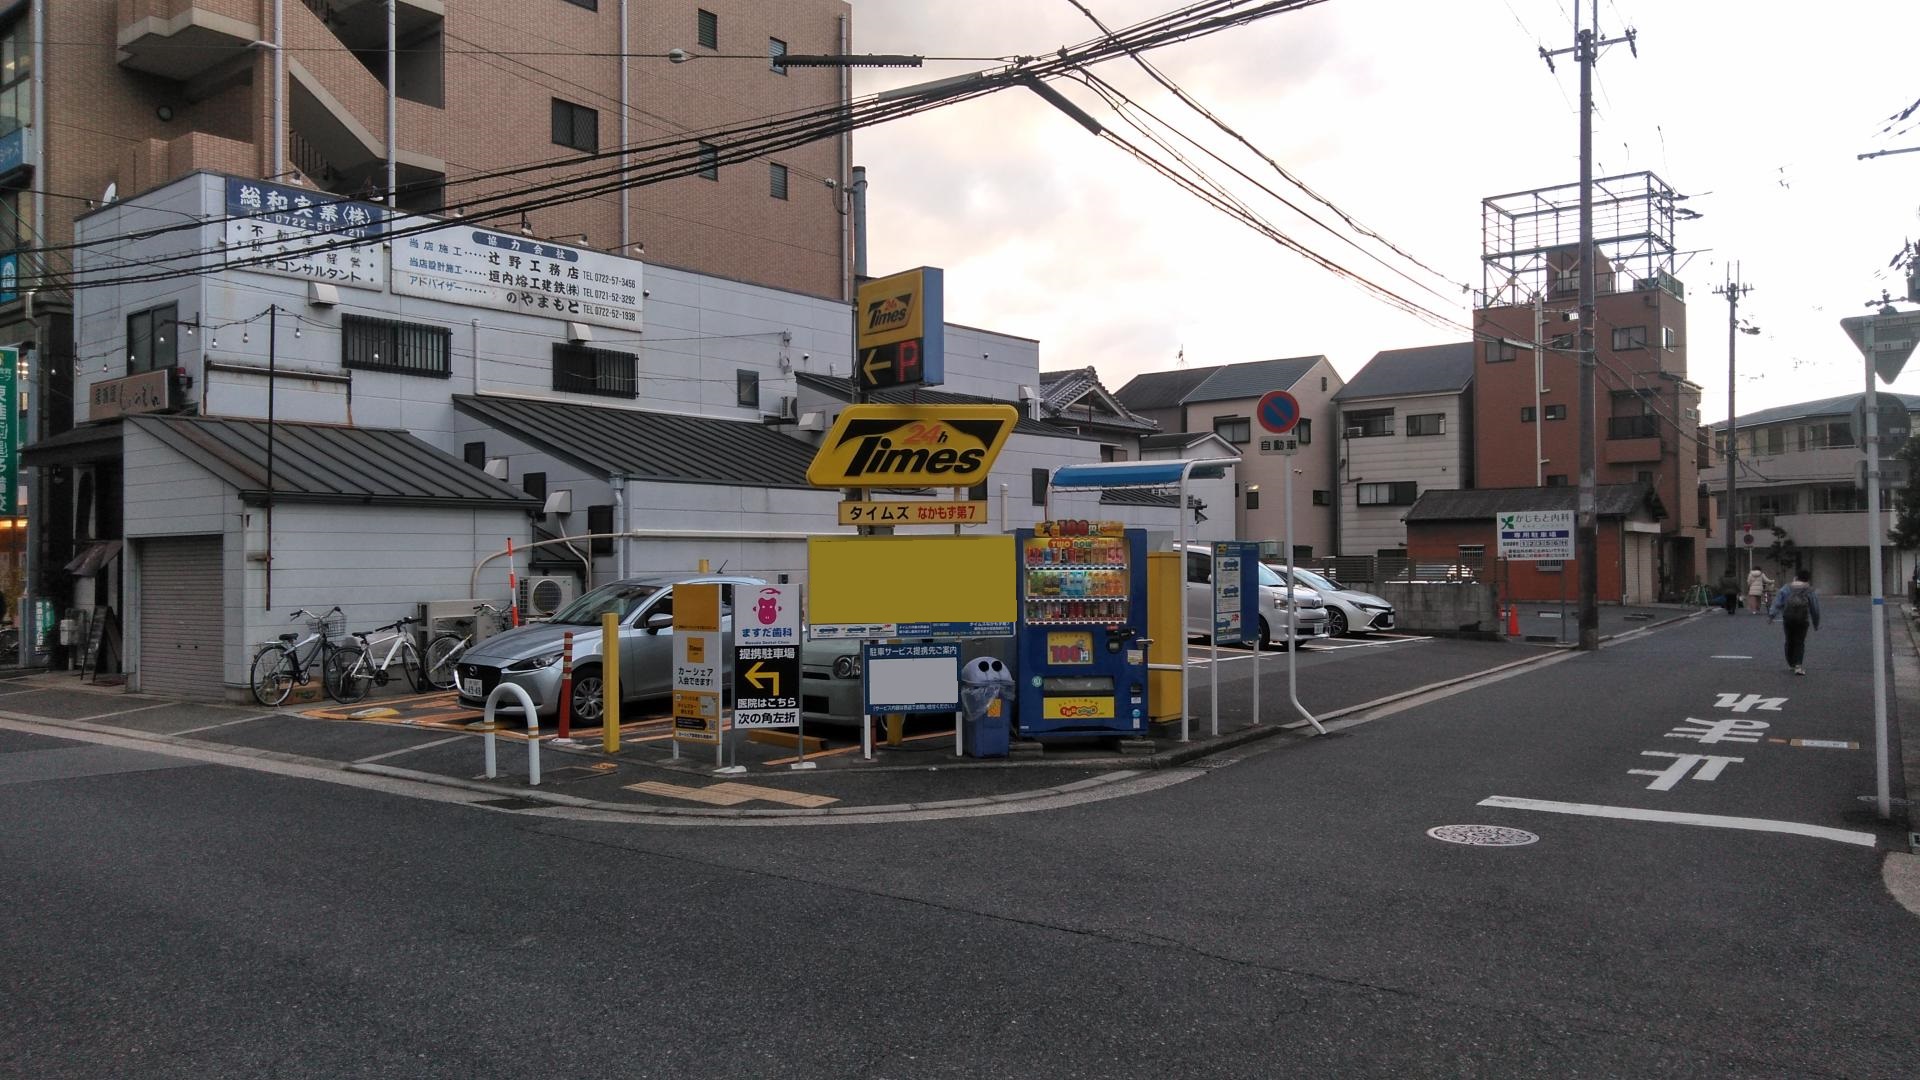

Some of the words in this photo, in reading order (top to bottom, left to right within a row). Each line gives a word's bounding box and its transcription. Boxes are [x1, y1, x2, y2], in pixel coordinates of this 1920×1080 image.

[488, 234, 567, 260] 協力会社
[409, 238, 463, 256] 当店施工
[488, 251, 580, 280] 辻野工務店
[583, 270, 594, 281] TEL
[409, 257, 463, 275] 当店設計施工
[583, 287, 594, 298] TEL
[409, 275, 463, 291] アドバイザー
[506, 291, 580, 314] のやまもと
[583, 304, 594, 315] TEL
[869, 308, 906, 330] Times
[899, 340, 919, 382] P
[904, 424, 948, 445] 24h
[1260, 439, 1297, 451] 自動車
[843, 435, 986, 477] Times
[850, 506, 910, 521] タイムズ
[917, 505, 976, 520] なかもず第7
[1516, 513, 1569, 523] かしもと内科
[741, 627, 793, 638] ますだ歯科
[739, 647, 796, 661] 提携駐車場
[869, 645, 957, 657] 駐車サービス提携先ご案内
[678, 667, 714, 677] カーシェア
[737, 697, 797, 709] 医院はこちら
[738, 711, 796, 725] 次の角左折
